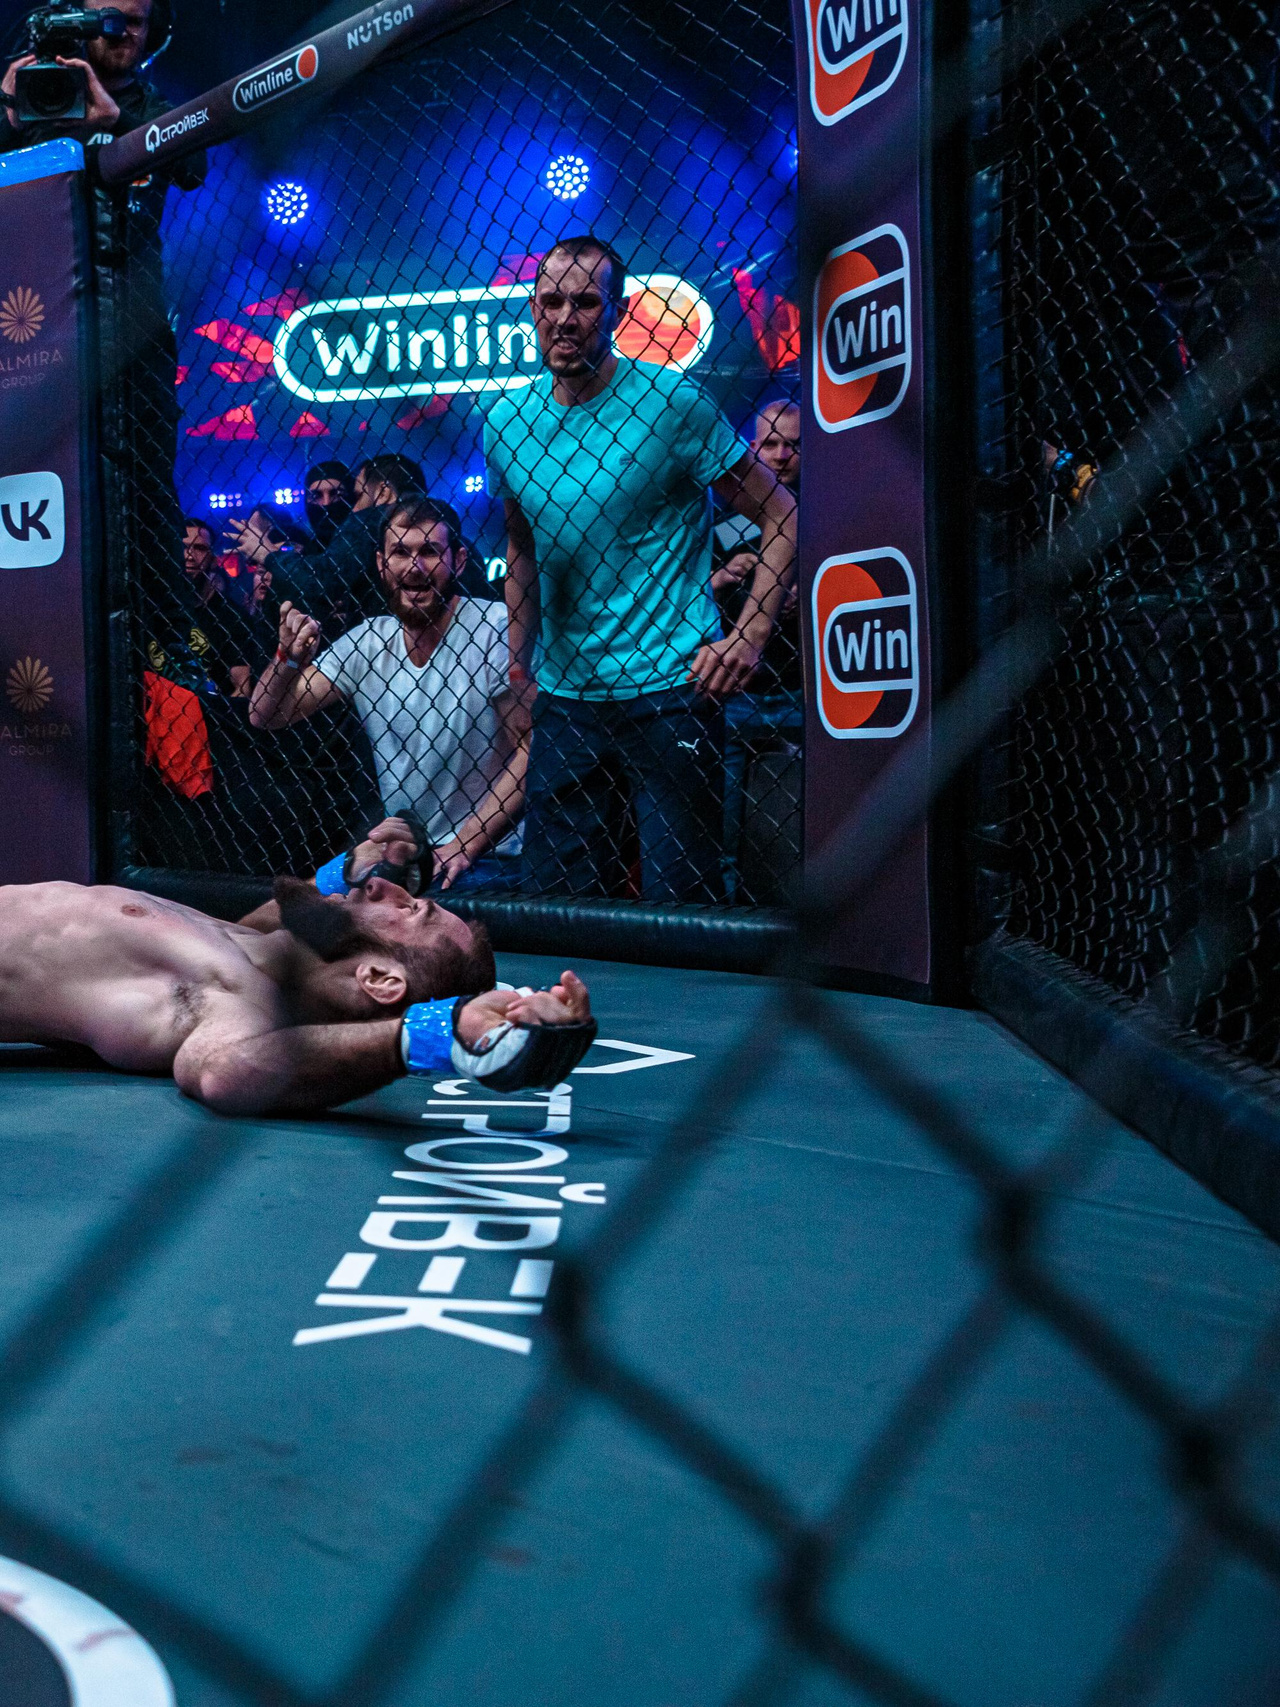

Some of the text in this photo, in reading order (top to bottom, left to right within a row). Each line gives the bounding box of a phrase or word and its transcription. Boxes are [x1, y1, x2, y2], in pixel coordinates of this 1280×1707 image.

[239, 66, 294, 104] Winline
[311, 311, 539, 378] Winlin
[833, 300, 902, 364] Win
[1, 372, 46, 390] GROUP
[0, 498, 52, 542] VK
[834, 618, 909, 673] Win
